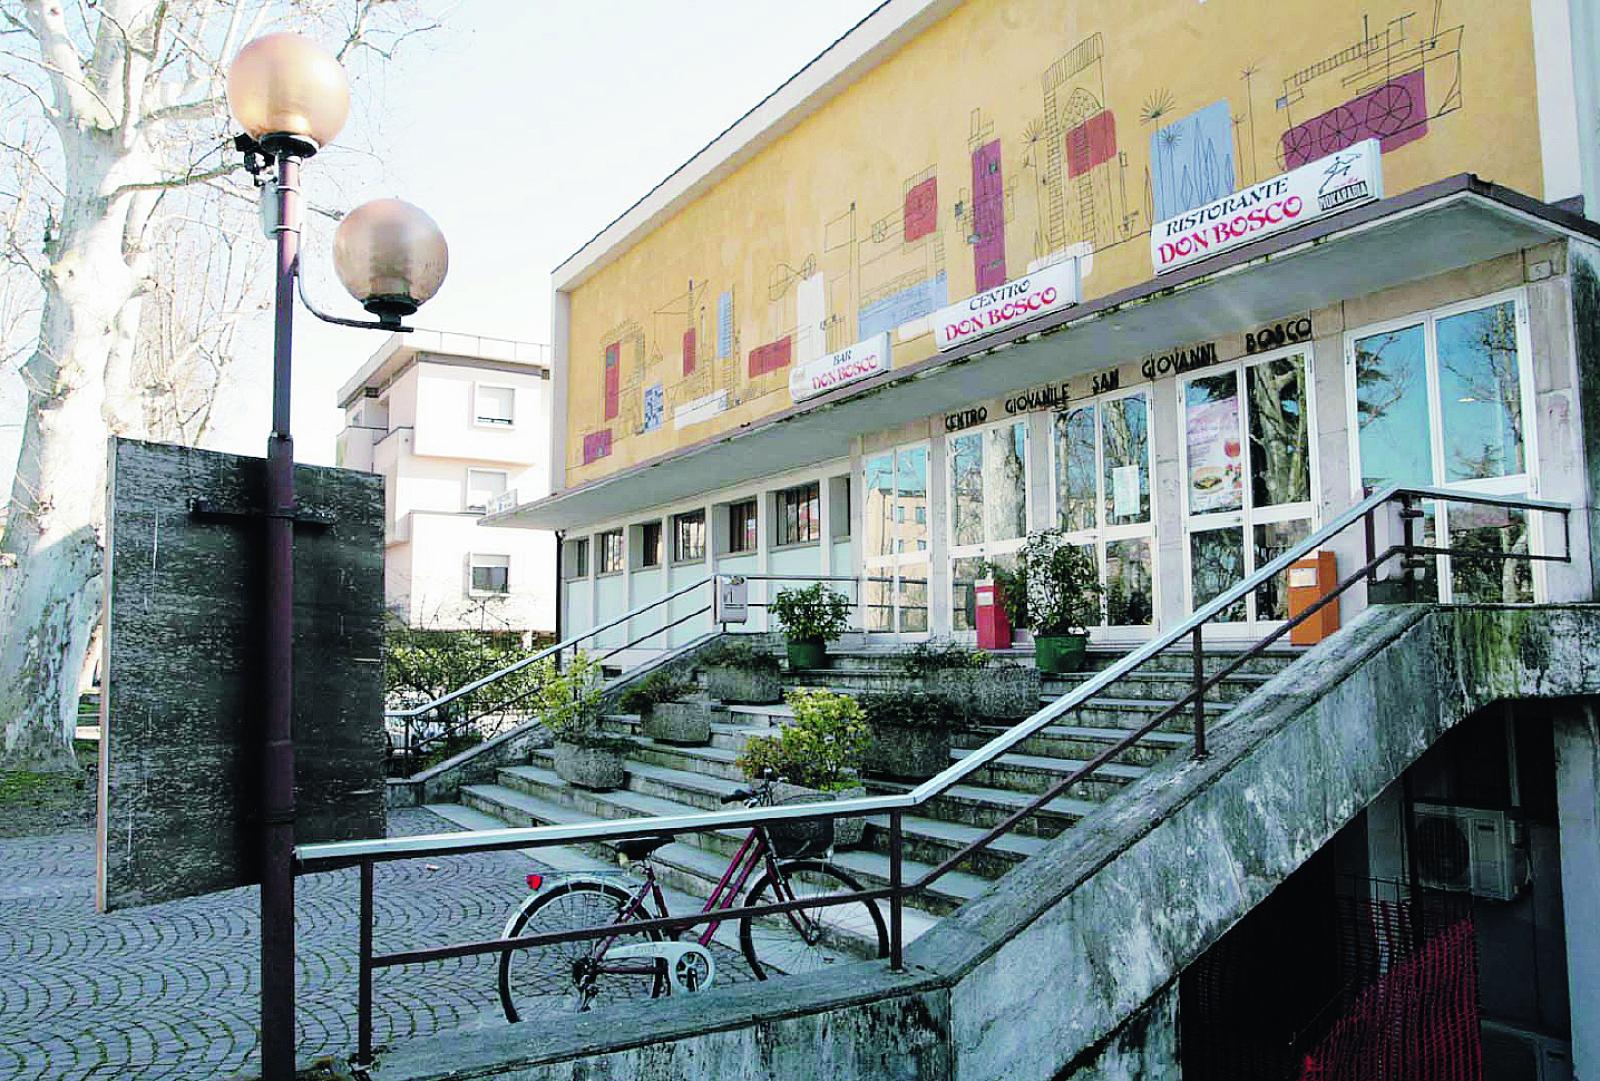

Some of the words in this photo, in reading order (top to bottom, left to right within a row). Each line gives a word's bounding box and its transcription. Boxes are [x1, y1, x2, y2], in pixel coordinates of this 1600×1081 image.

[1158, 231, 1209, 264] DON
[1213, 195, 1303, 244] BOSCO
[1166, 176, 1289, 236] RISTORANTE
[945, 314, 985, 341] DON
[987, 287, 1057, 326] BOSCO
[969, 279, 1030, 311] CENTRO
[812, 371, 836, 389] DON
[837, 354, 878, 381] BOSCO
[833, 349, 852, 366] BAR
[945, 407, 988, 430] CENTRO
[1005, 383, 1070, 416] GIOVANILE
[1092, 368, 1120, 395] SAN
[1141, 343, 1218, 379] GIOVANNI
[1245, 318, 1312, 353] BOSCO
